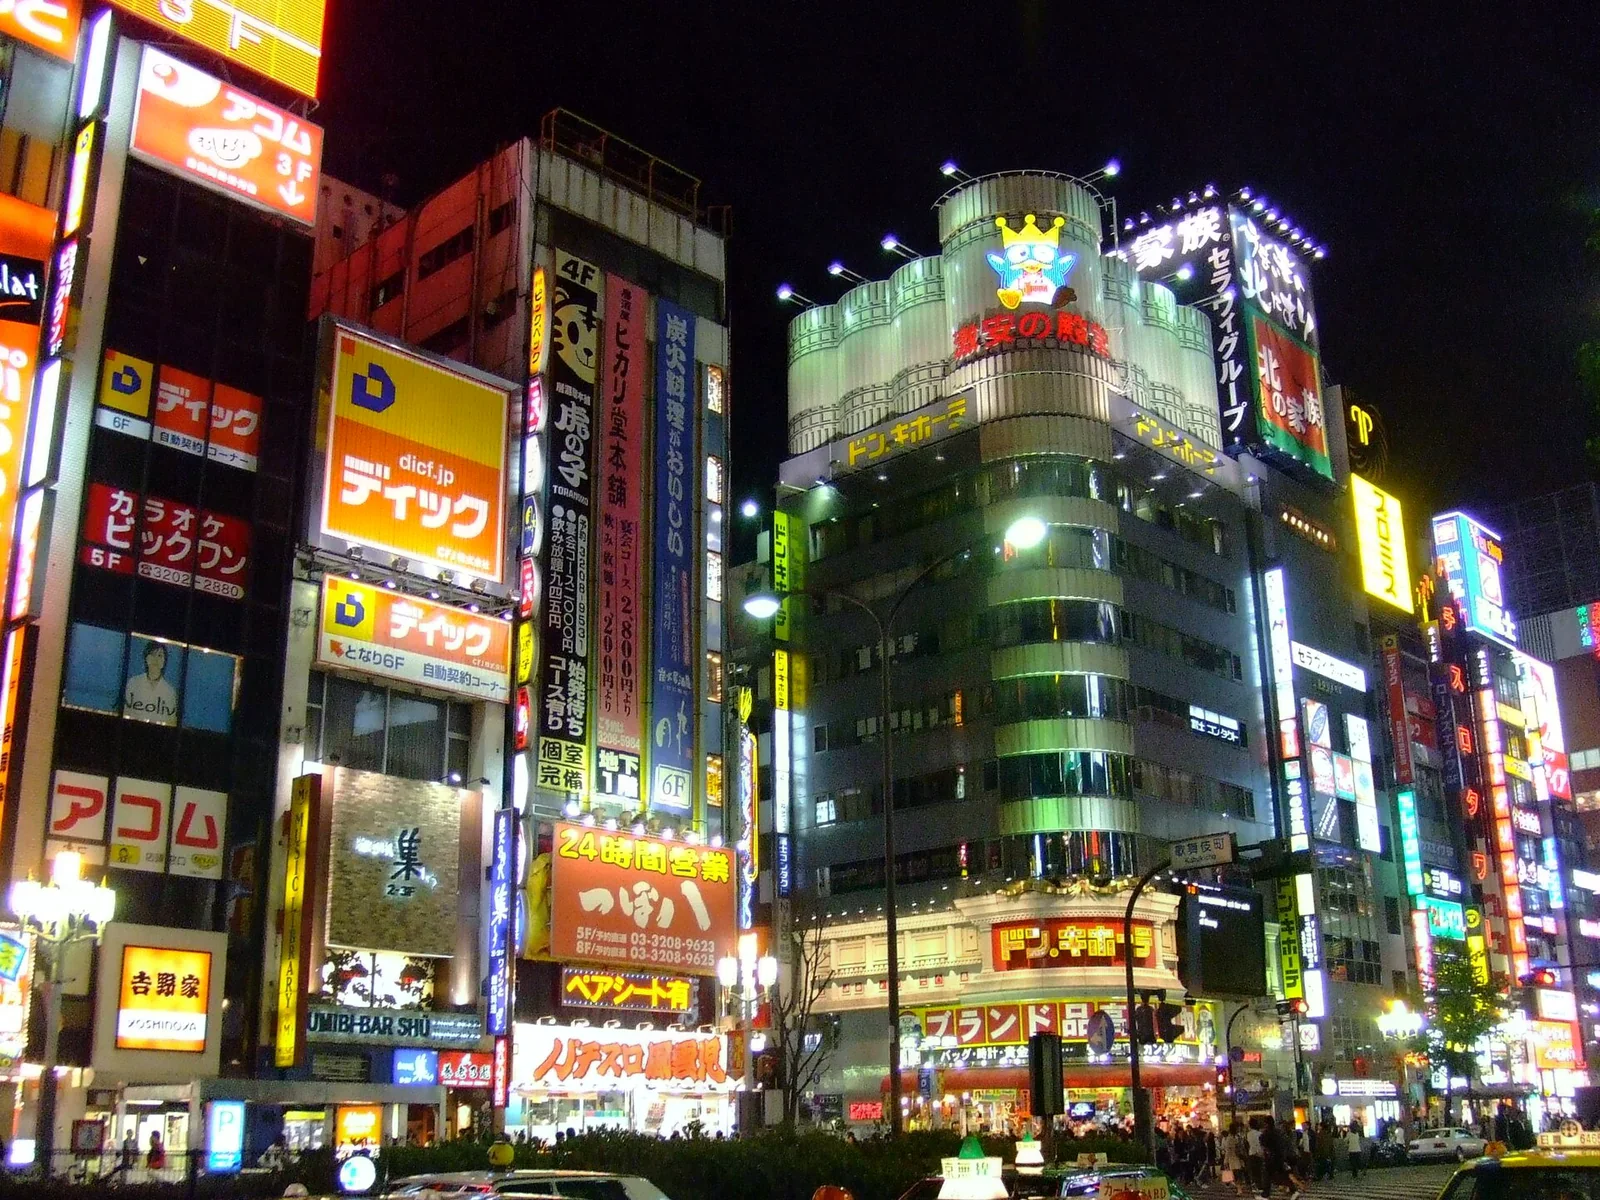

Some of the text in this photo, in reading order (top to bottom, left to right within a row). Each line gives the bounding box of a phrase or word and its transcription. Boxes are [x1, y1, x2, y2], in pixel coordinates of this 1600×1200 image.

[221, 90, 312, 156] アコム
[276, 152, 313, 183] 3F
[561, 258, 596, 286] 4F
[1258, 344, 1323, 434] 北の家族
[112, 416, 130, 431] 6F
[155, 380, 258, 437] ディック
[607, 321, 630, 509] ヒカリ堂本舗
[554, 400, 591, 488] 虎の子
[399, 454, 455, 487] dicf.jp
[341, 454, 489, 539] ディック
[109, 490, 226, 538] カラオケ
[90, 550, 122, 568] 5F
[390, 600, 491, 656] ディック
[345, 644, 405, 671] となり6F
[546, 654, 567, 730] コース有り
[566, 659, 585, 737] 始発待ち
[1189, 718, 1240, 742] 富士コンタクト
[540, 739, 584, 764] 個室
[599, 749, 639, 775] 地下
[539, 764, 584, 791] 完備
[601, 770, 638, 798] 1階
[662, 773, 686, 798] 6F
[53, 783, 219, 850] アコム
[390, 827, 424, 881] 巣
[558, 828, 730, 884] 24時間営業
[578, 879, 712, 932] つぼ八
[130, 970, 201, 999] 吉野家
[566, 976, 691, 1010] ペアシート有
[127, 1018, 197, 1032] YOSHINOYA
[218, 1110, 234, 1133] P
